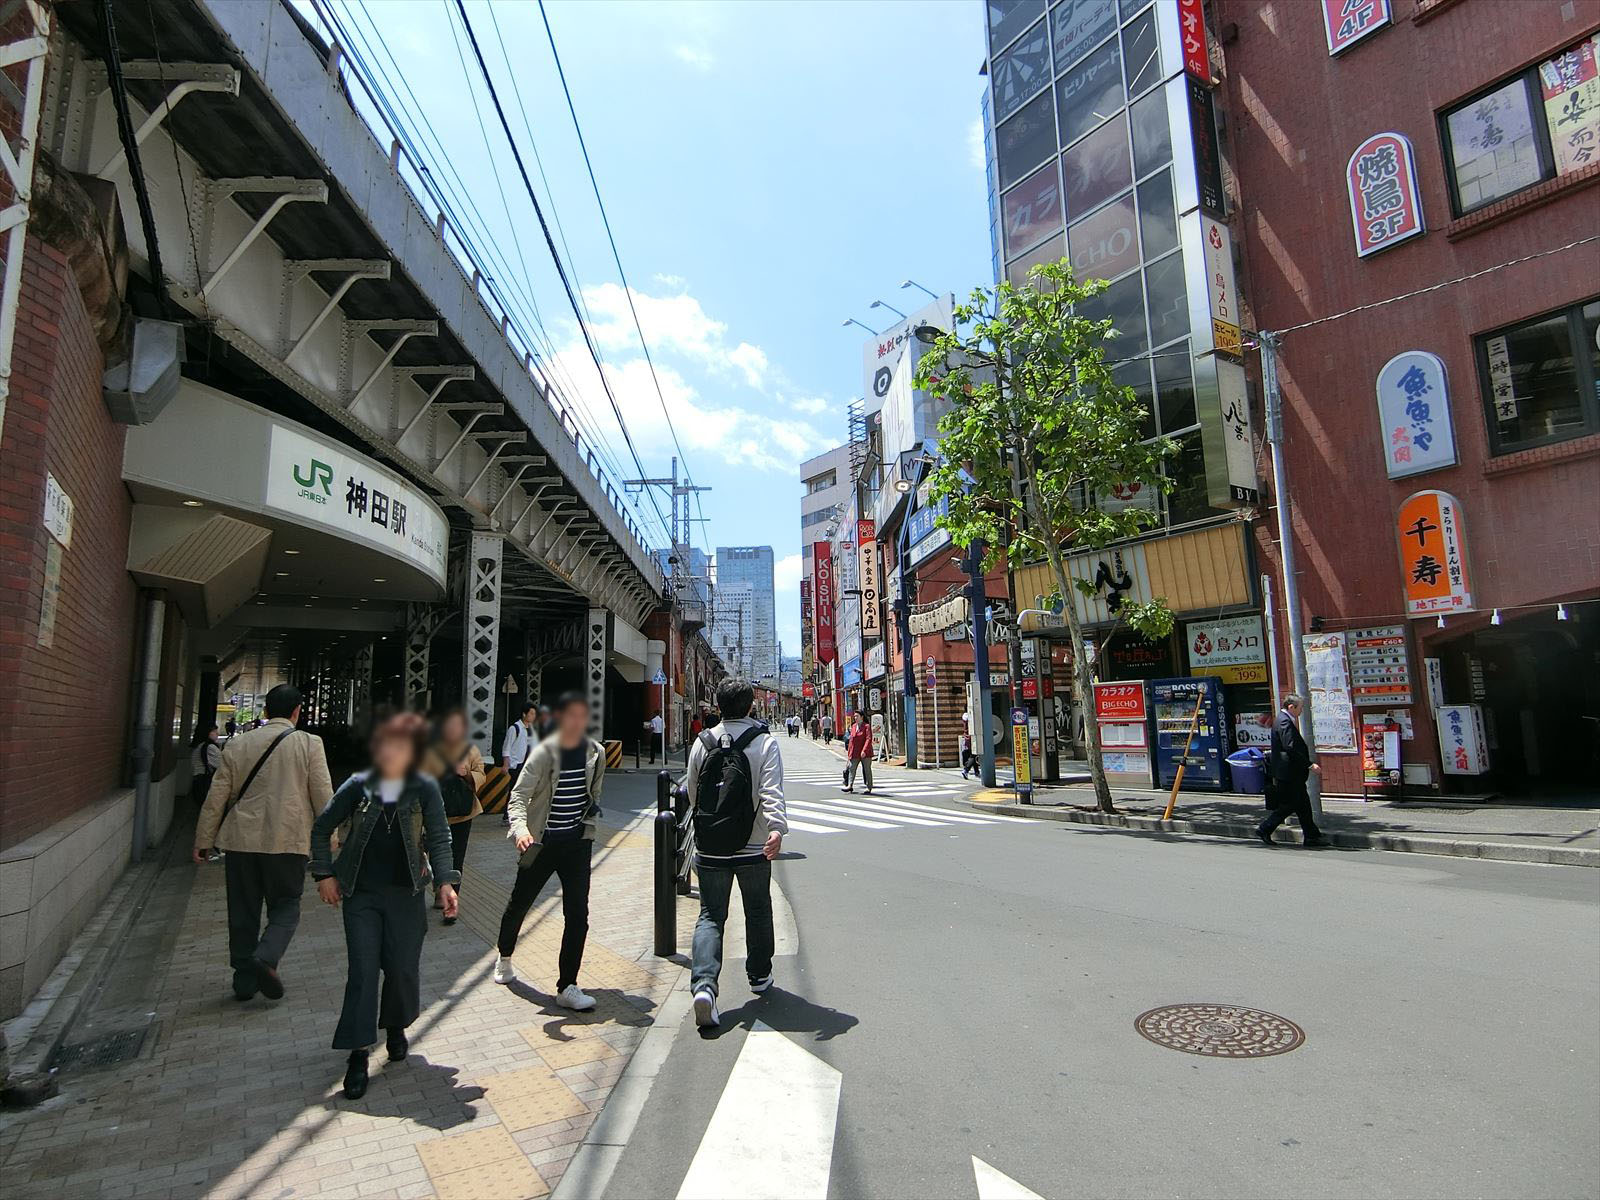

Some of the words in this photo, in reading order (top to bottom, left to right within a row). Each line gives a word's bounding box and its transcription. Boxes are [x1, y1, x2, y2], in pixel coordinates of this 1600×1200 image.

[1337, 6, 1373, 40] 4F
[1189, 59, 1202, 74] 4F
[1357, 142, 1404, 220] 焼鳥
[1368, 211, 1405, 243] 3F
[1214, 322, 1237, 338] 生ビール
[293, 458, 334, 496] JR
[297, 489, 327, 505] JR東日本
[346, 476, 407, 537] 神田駅
[1406, 517, 1442, 585] 千寿
[1442, 506, 1462, 586] さらりーまん割烹
[863, 548, 873, 586] 中華食堂
[863, 588, 878, 630] 日高屋
[1415, 596, 1464, 610] 地下一階
[1217, 635, 1259, 652] 鳥メロ
[1101, 686, 1136, 697] カラオケ
[1172, 683, 1197, 691] BOSS
[1102, 701, 1117, 710] BIG
[1117, 699, 1138, 709] ECHO
[1218, 705, 1227, 739] BOSS
